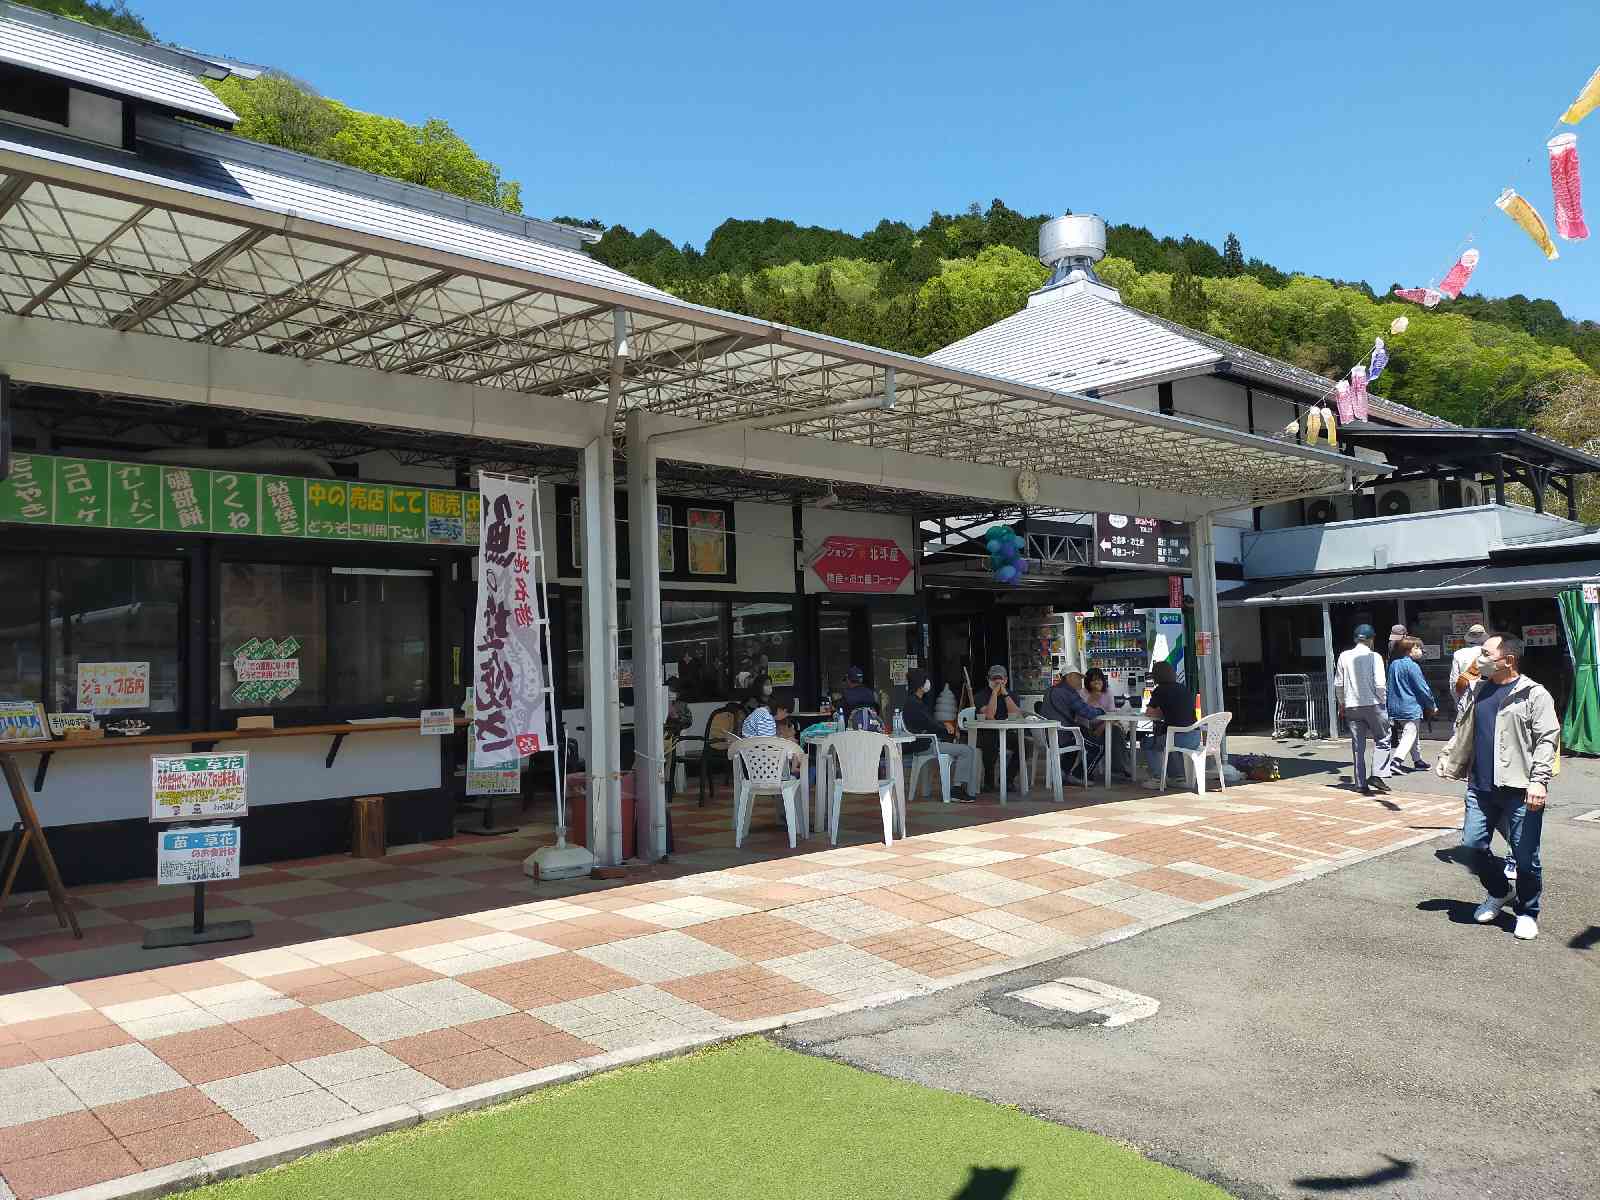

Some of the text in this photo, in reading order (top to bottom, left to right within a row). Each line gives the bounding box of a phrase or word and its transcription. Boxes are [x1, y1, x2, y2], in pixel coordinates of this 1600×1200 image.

[63, 463, 100, 523] コロッケ
[117, 467, 155, 524] カレーパン
[216, 474, 250, 529] つくね
